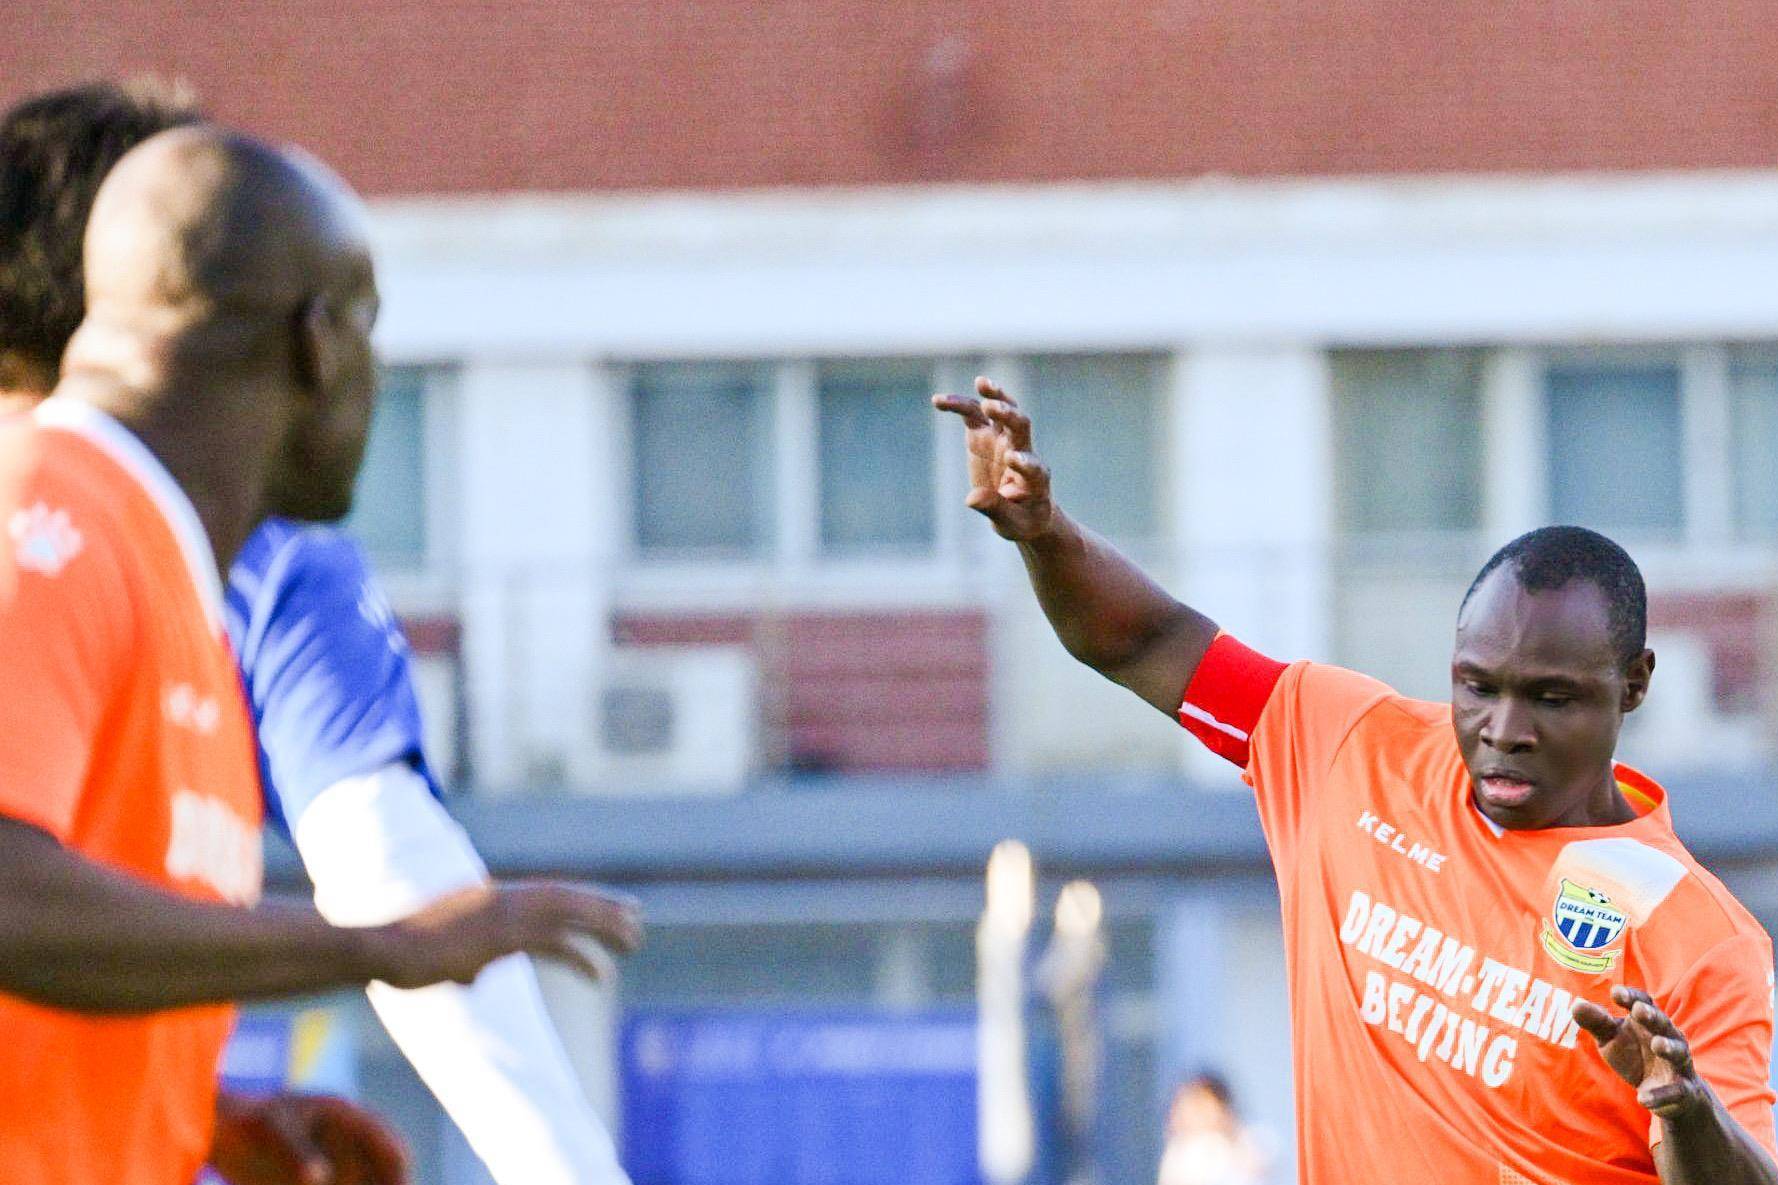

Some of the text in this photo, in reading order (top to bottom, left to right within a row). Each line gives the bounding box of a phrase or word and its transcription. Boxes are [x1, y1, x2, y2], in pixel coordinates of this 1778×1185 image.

[1356, 809, 1447, 873] KELME
[1560, 902, 1596, 917] DREAM
[1597, 911, 1622, 924] TEAM
[1359, 971, 1518, 1088] BEIJING
